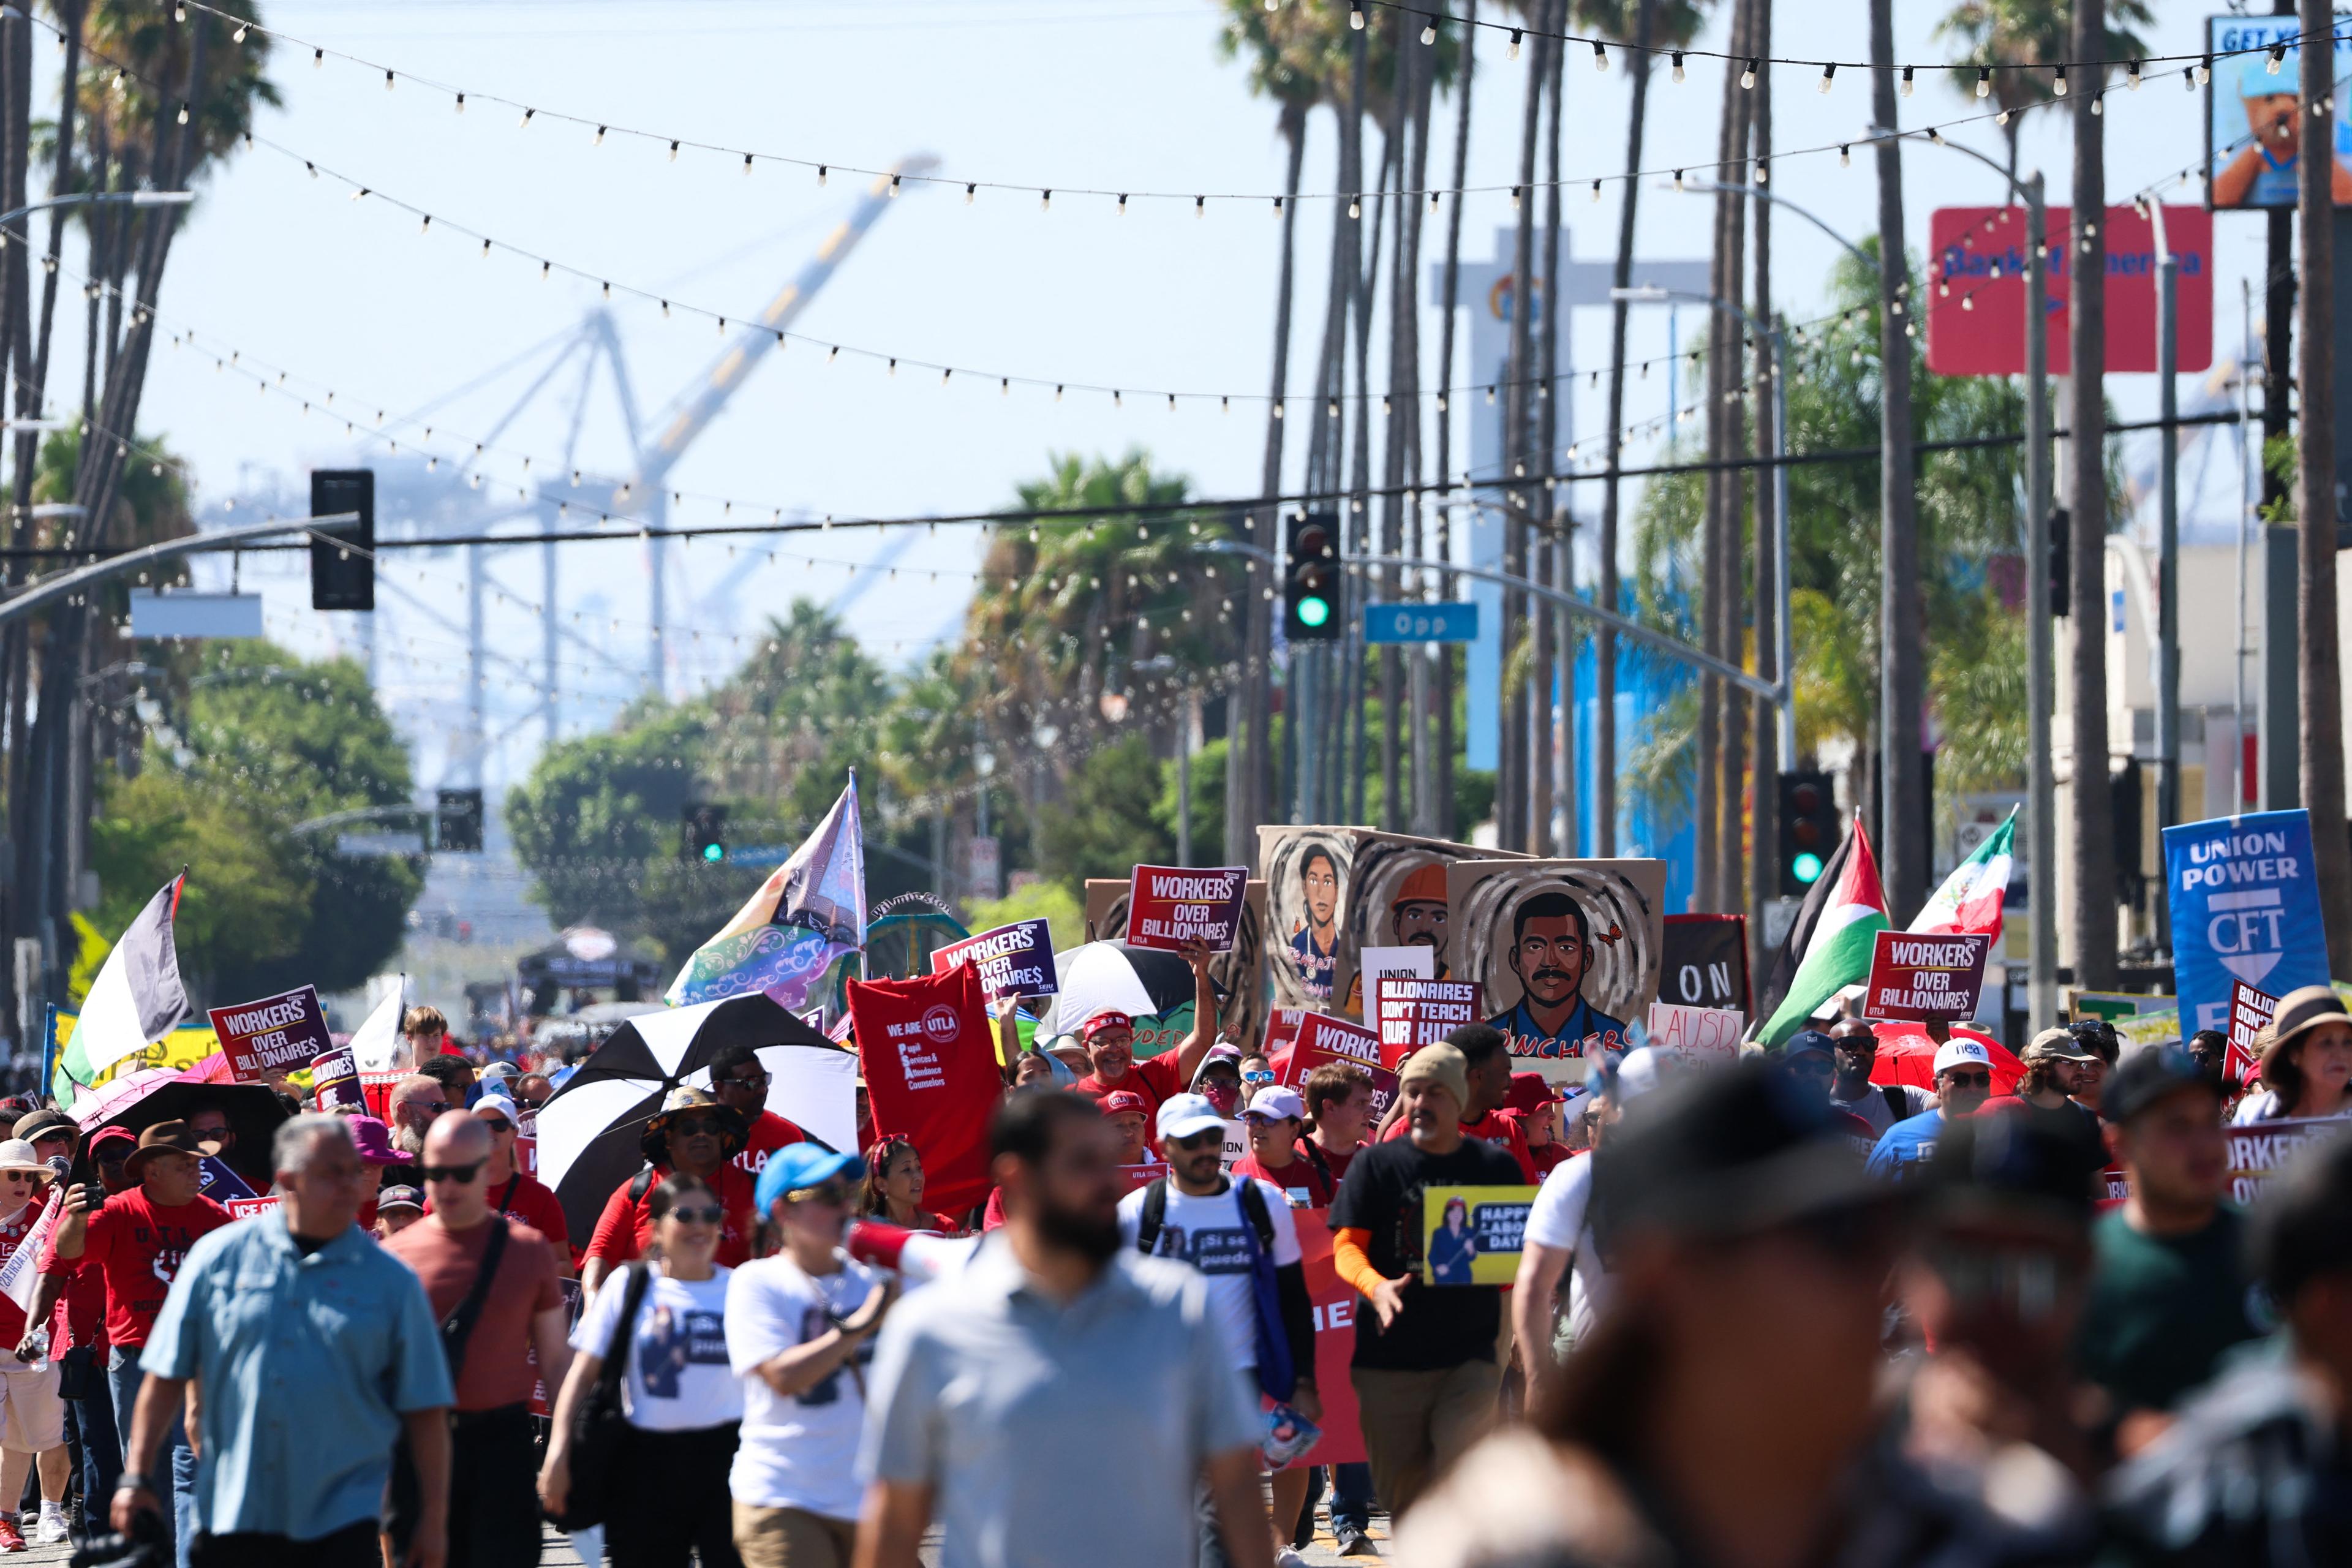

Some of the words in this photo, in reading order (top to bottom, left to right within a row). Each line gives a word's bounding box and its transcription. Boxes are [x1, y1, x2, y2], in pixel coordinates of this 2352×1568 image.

[2223, 28, 2266, 51] GET
[1395, 612, 1447, 636] Opp
[2190, 831, 2285, 864] UNION
[2182, 857, 2299, 891] POWER
[1152, 875, 1234, 899] WORKERS
[871, 891, 952, 919] Wilmington
[1174, 904, 1209, 922] OVER
[1141, 919, 1229, 941] BILLIONAIRE$
[2207, 908, 2285, 953] CFT
[1891, 941, 1975, 967] WORKERS
[981, 966, 1043, 993] ONAIRE$
[1379, 968, 1416, 979] UNION
[1679, 962, 1731, 1003] ON
[1913, 971, 1950, 990] OVER
[1382, 981, 1472, 1001] BILLIONAIRES
[1879, 988, 1969, 1011] BILLIONAIRE$
[2238, 985, 2276, 1014] BILLIO
[223, 1000, 305, 1035] WORKERS
[1382, 1001, 1415, 1018] DON'T
[1420, 1002, 1471, 1021] TEACH
[887, 1023, 904, 1038] WE
[905, 1021, 922, 1035] ARE
[927, 1016, 956, 1031] UTLA
[1382, 1020, 1411, 1045] OUR
[2235, 1022, 2255, 1049] OU
[252, 1031, 288, 1052] OVER
[898, 1042, 921, 1055] Pupil
[1316, 1024, 1381, 1065] WORKE
[1956, 1043, 1980, 1055] nea
[235, 1036, 320, 1071] BILLONAIRE$
[901, 1055, 932, 1067] Services
[932, 1052, 938, 1062] &
[905, 1066, 941, 1080] Attendance
[908, 1077, 945, 1090] Counselors
[1288, 1084, 1303, 1095] UTLA
[1111, 1096, 1127, 1106] UTLA
[1221, 1142, 1243, 1153] ION
[233, 1204, 258, 1219] ICE
